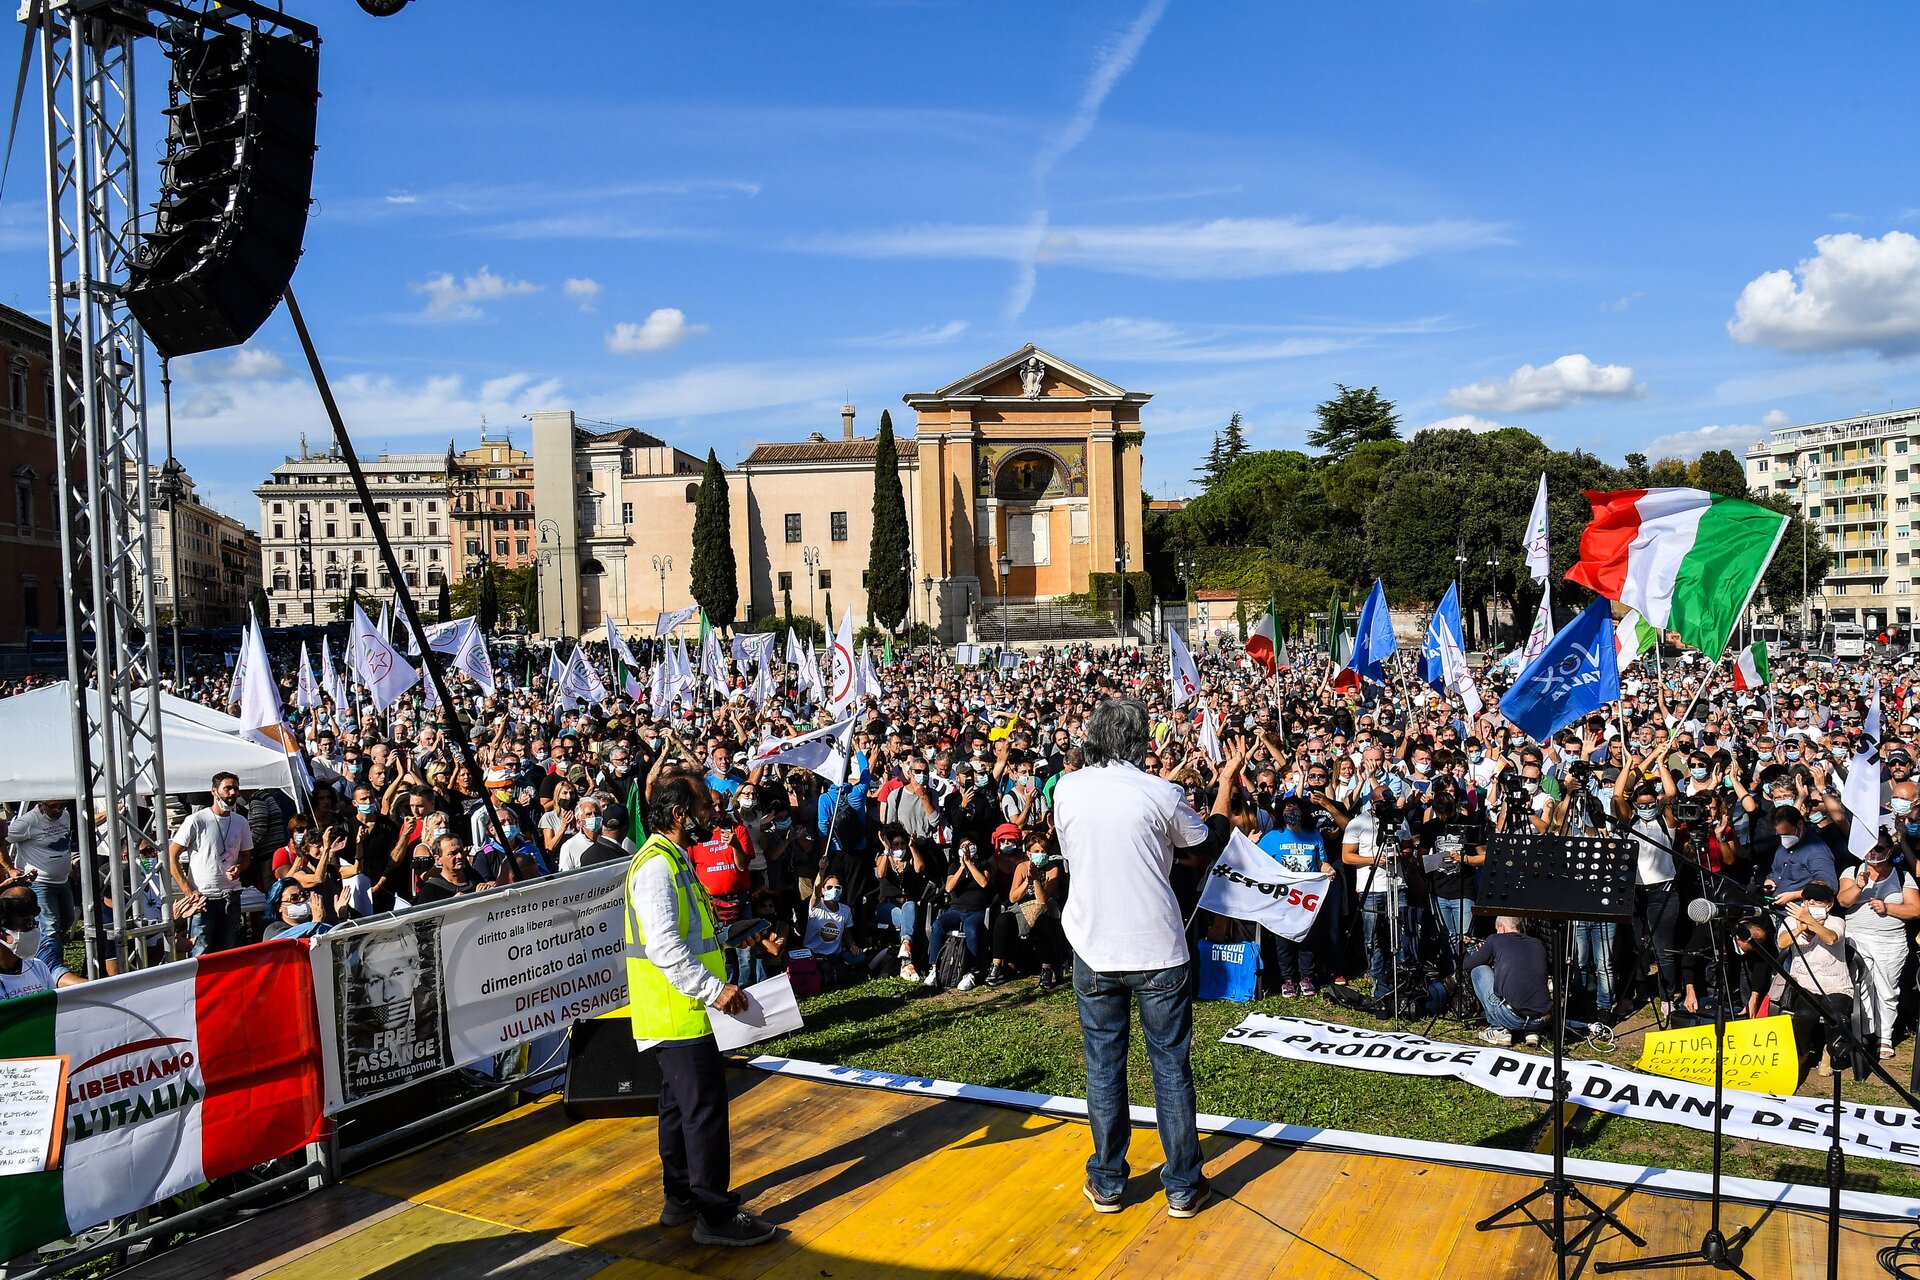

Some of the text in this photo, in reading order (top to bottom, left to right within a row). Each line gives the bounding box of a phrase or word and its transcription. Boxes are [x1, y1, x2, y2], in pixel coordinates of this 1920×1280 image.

[477, 931, 507, 946] diritto
[509, 924, 525, 939] alla
[577, 896, 625, 919] informazion
[486, 901, 539, 922] Arrestato
[541, 898, 560, 911] per
[562, 892, 585, 904] aver
[587, 882, 616, 899] difeso
[508, 921, 608, 961] Ora torturato e
[1212, 950, 1244, 965] DI BELLA
[481, 940, 626, 995] dimenticato dai medi
[515, 968, 612, 1012] DIFENDIAMO
[500, 984, 628, 1042] JULIAN ASSANGE
[355, 1038, 435, 1074] ASSANGE
[373, 1024, 417, 1050] FREE
[1752, 1030, 1778, 1049] LA
[68, 1051, 194, 1104] LIBERIAMO
[356, 1077, 369, 1087] NO
[370, 1073, 387, 1084] U.S.
[387, 1059, 437, 1080] EXTRADITION
[1670, 1066, 1739, 1077] LAVOO
[73, 1077, 200, 1141] L'ITALIA
[1282, 1034, 1482, 1066] PRODUCE
[1581, 1075, 1736, 1121] DANNI
[1751, 1110, 1920, 1158] DELLE
